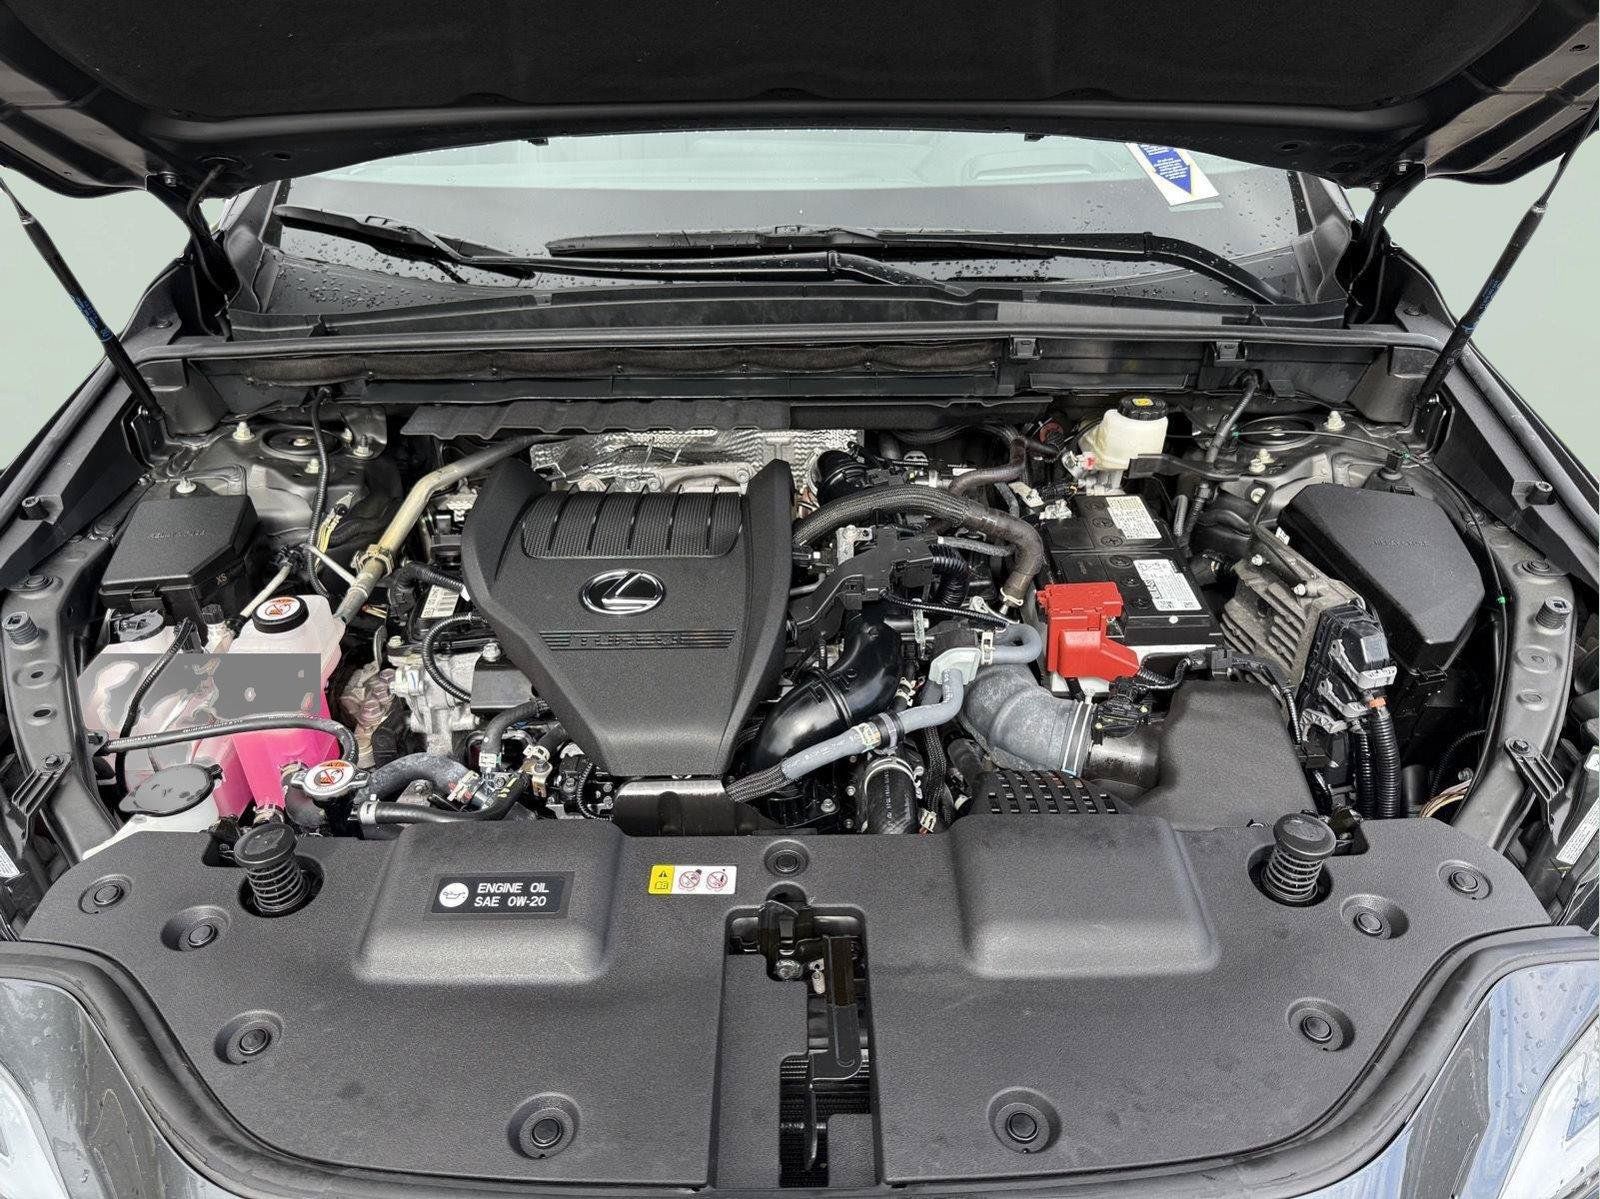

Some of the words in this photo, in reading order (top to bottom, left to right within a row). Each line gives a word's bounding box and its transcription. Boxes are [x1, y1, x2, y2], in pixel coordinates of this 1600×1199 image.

[477, 882, 523, 893] ENGINE
[530, 882, 549, 893] OIL
[474, 896, 501, 907] SAE
[508, 896, 547, 907] 0W-20
